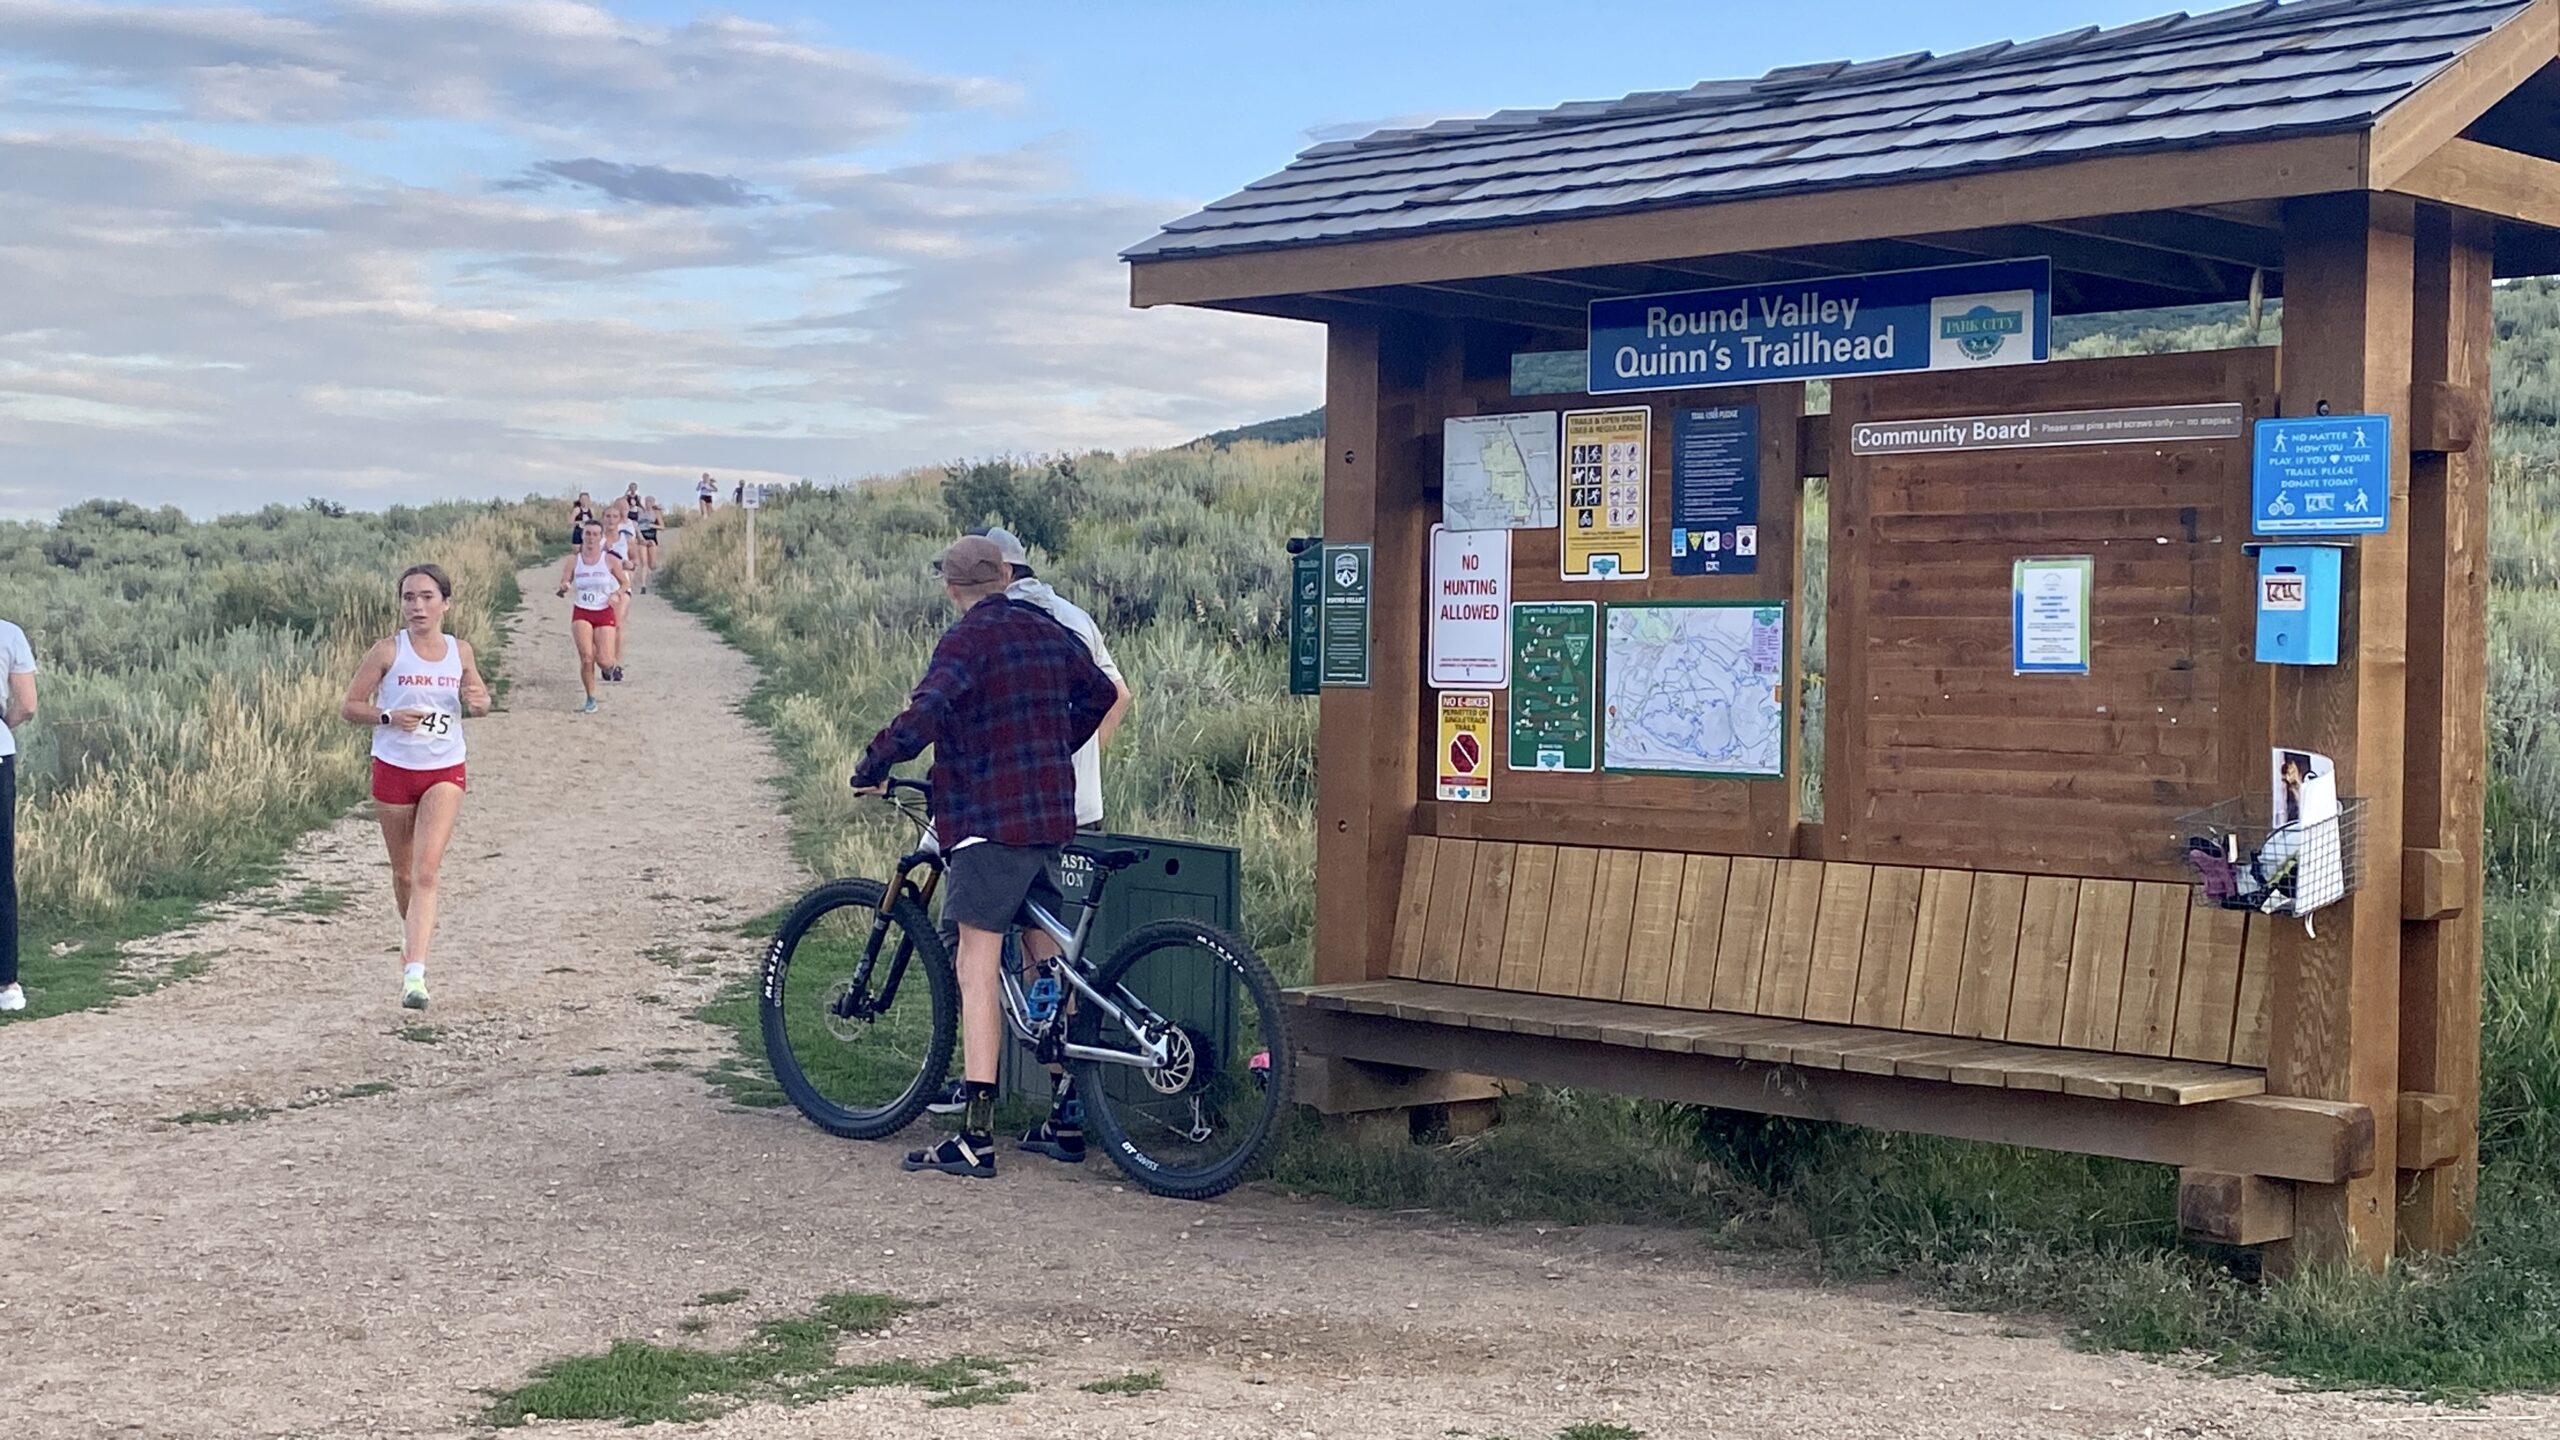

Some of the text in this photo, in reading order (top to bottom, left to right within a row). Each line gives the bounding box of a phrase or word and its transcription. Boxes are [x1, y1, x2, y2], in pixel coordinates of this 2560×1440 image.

[1646, 292, 1860, 339] Round Valley
[1946, 317, 2016, 334] PARK CITY
[1614, 324, 1895, 379] Quinn's Trailhead
[1569, 414, 1643, 425] TRAILS & OPEN SPACE
[2041, 423, 2068, 433] Please
[2086, 421, 2104, 433] pins
[2106, 420, 2122, 430] and
[2123, 420, 2153, 429] screws
[2154, 419, 2174, 430] only
[1595, 424, 1643, 433] REGULATIONS
[1857, 418, 2031, 447] Community Board
[2291, 431, 2348, 442] NO MATTER
[2295, 443, 2343, 454] HOW YOU
[2295, 457, 2304, 465] IF
[2306, 455, 2327, 464] YOU
[2343, 453, 2371, 463] YOUR
[2321, 465, 2354, 475] PLEASE
[2280, 478, 2319, 488] DONATE
[1462, 554, 1479, 571] NO
[1443, 578, 1497, 595] HUNTING
[581, 593, 595, 603] 40
[1440, 603, 1499, 620] ALLOWED
[398, 675, 460, 689] PARK CIT
[1442, 697, 1489, 707] NO E-BIKES
[1442, 708, 1478, 716] PERMITTED
[421, 711, 451, 735] 45
[1444, 716, 1487, 724] SINGLETRACK
[1454, 723, 1477, 732] TRAILS
[1060, 853, 1094, 871] ASTE
[1060, 871, 1085, 888] ION
[1196, 935, 1245, 973] MAXXIS
[765, 939, 784, 999] MAXXIS
[1121, 1141, 1160, 1171] DT SWISS
